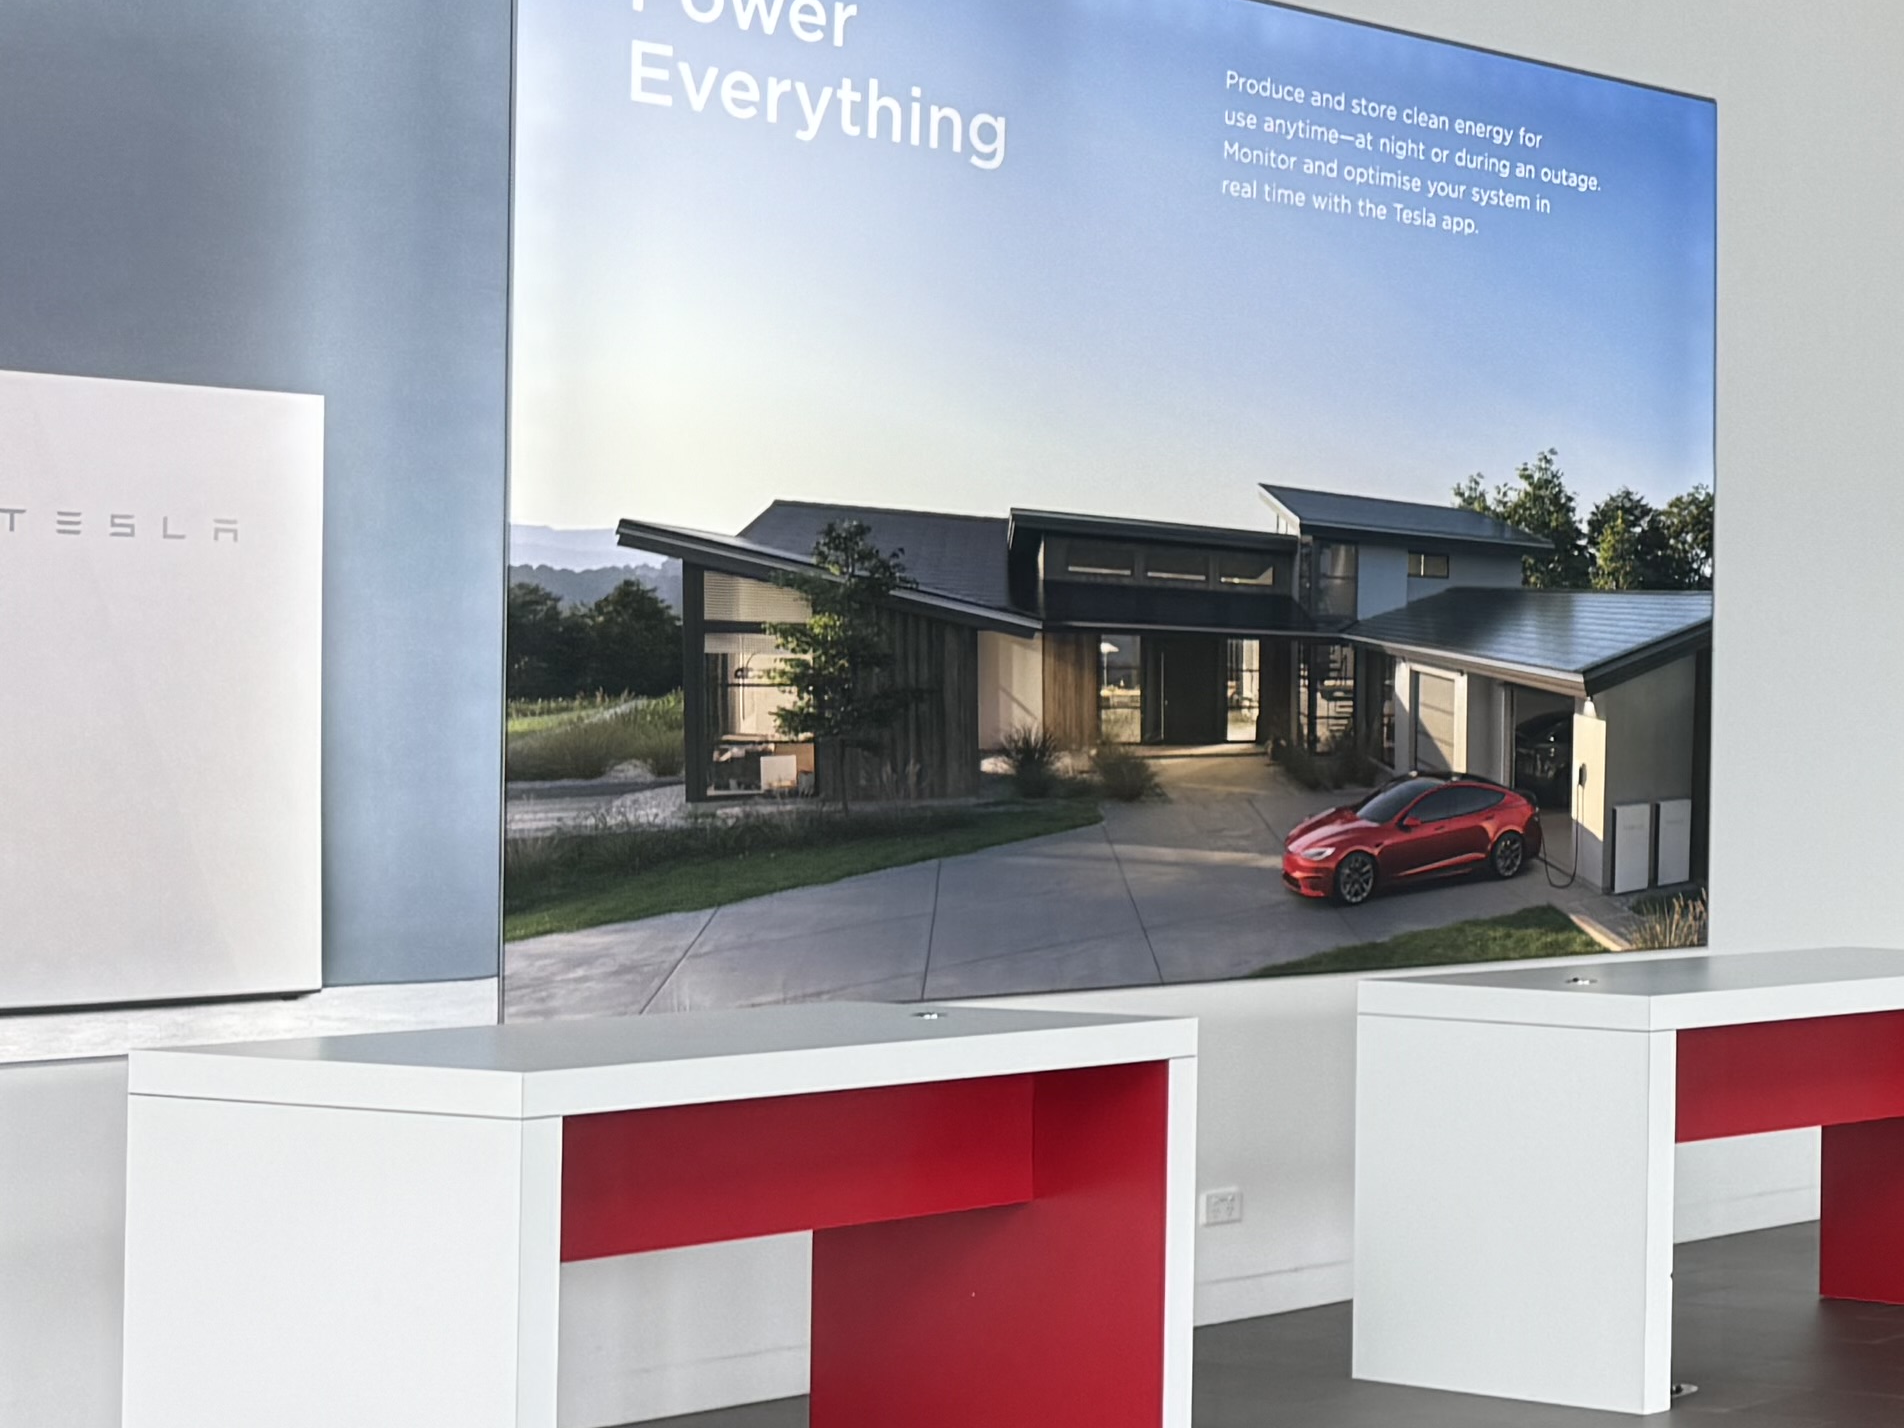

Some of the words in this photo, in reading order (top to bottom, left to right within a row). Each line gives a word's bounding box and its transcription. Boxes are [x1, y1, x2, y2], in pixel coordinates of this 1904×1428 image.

[630, 39, 1006, 169] Everything
[1226, 70, 1305, 103] Produce
[1311, 90, 1345, 111] and
[1351, 97, 1397, 121] store
[1403, 105, 1449, 131] clean
[1454, 118, 1514, 146] energy
[1519, 126, 1543, 149] for
[1223, 140, 1297, 171] Monitor
[1303, 158, 1338, 177] and
[1343, 165, 1421, 192] optimise
[1427, 179, 1466, 199] your
[1471, 186, 1530, 210] system
[1536, 194, 1550, 214] in
[1224, 110, 1257, 129] use
[1379, 135, 1425, 160] night
[1431, 147, 1449, 163] or
[1455, 148, 1510, 177] during
[1515, 162, 1535, 179] an
[1541, 167, 1601, 192] outage.
[1222, 179, 1257, 199] real
[1264, 182, 1305, 207] time
[1312, 192, 1351, 214] with
[1358, 197, 1387, 220] the
[1393, 203, 1436, 228] Tesla
[1442, 214, 1479, 236] app.
[0, 508, 239, 543] TESLA
